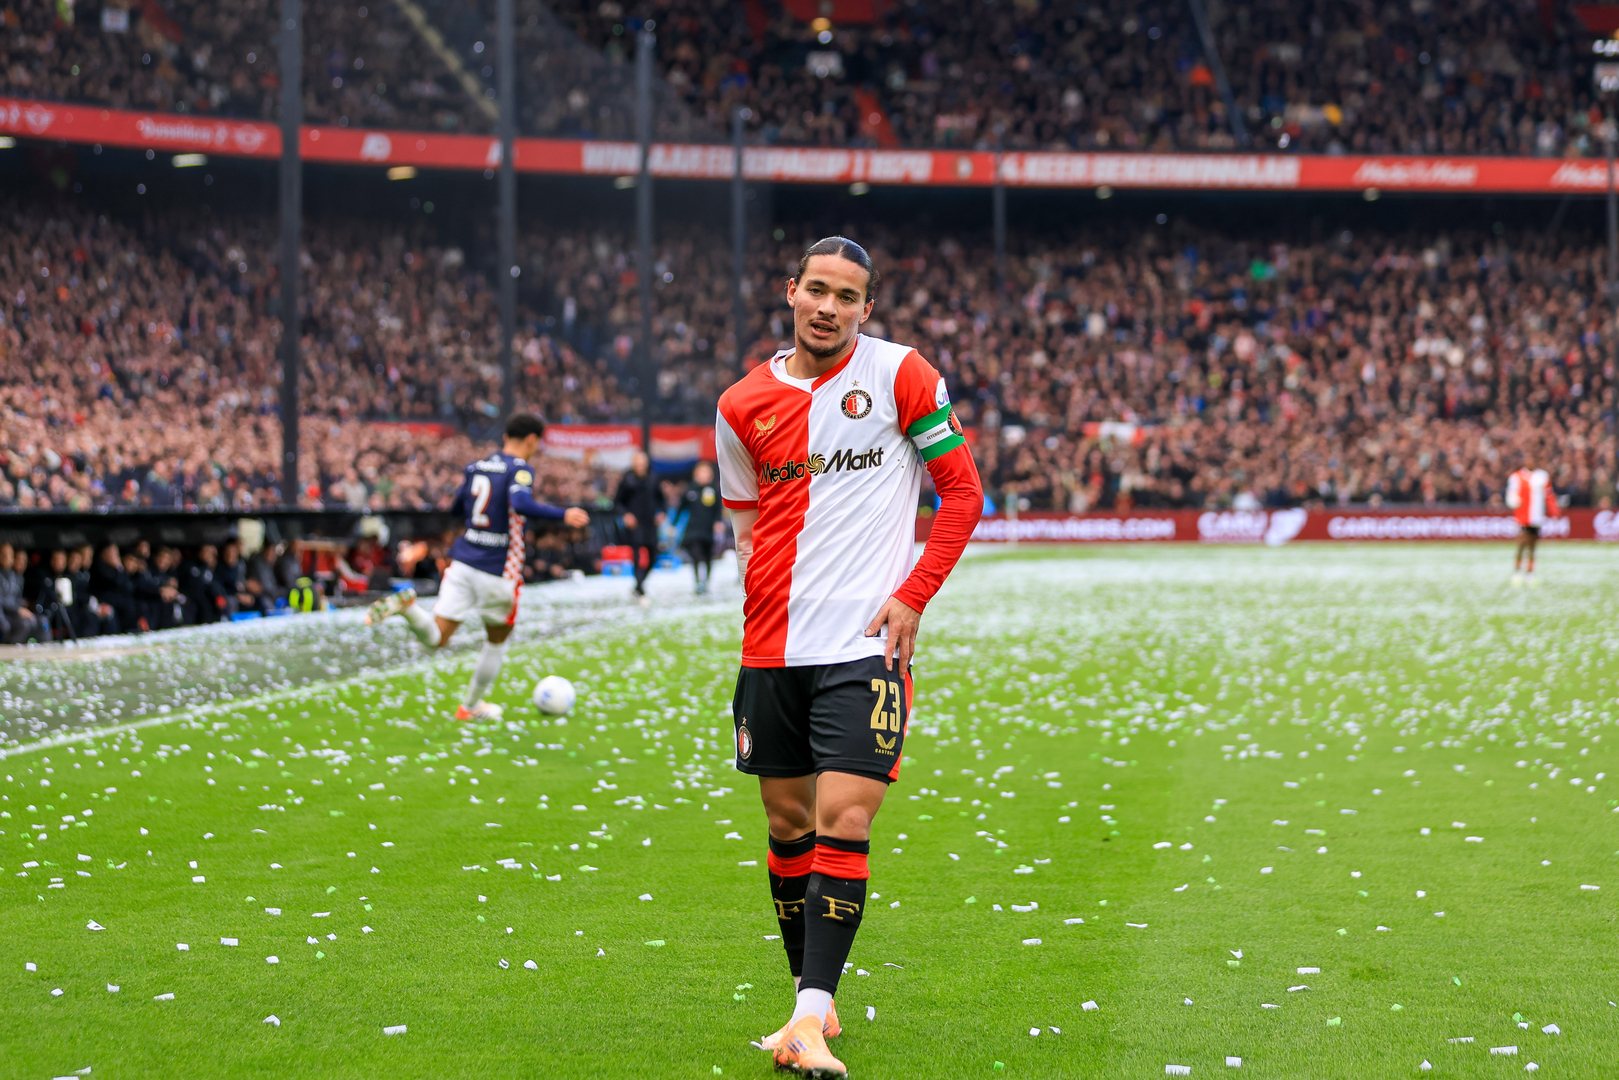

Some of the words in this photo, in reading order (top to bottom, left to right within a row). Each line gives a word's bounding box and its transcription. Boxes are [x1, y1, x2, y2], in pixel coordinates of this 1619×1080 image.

[760, 459, 806, 485] Media
[822, 446, 884, 474] Markt
[470, 474, 491, 527] 2
[870, 678, 901, 733] 23
[821, 894, 860, 920] F
